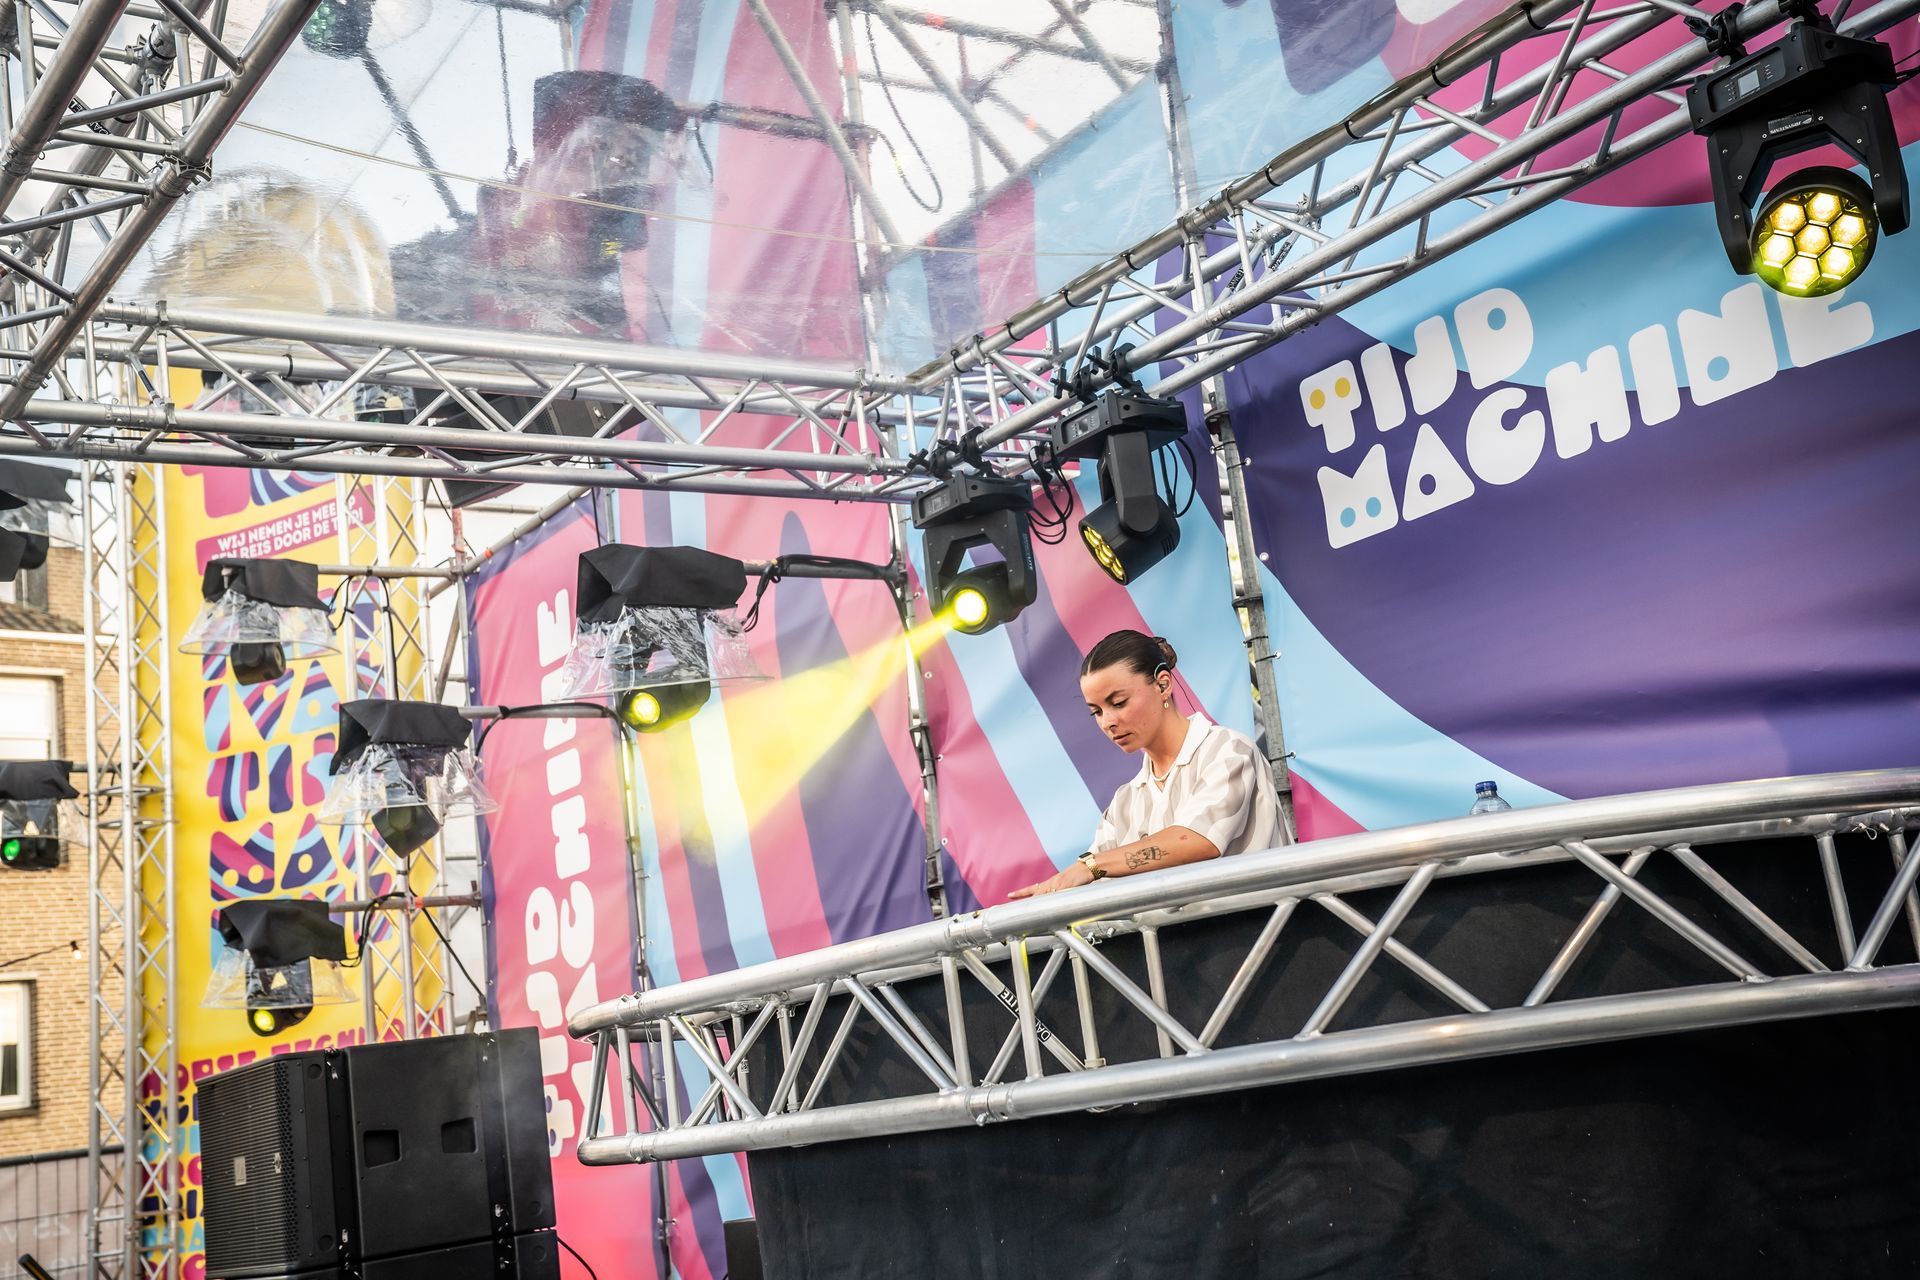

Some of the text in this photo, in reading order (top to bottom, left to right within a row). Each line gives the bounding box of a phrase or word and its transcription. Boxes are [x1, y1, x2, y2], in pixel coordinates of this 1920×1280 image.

[1299, 288, 1534, 453] TIJD
[1317, 282, 1875, 549] MACHINE
[217, 534, 246, 552] WIJ
[248, 516, 293, 544] NEMEN
[294, 511, 310, 528] JE
[240, 538, 271, 559] REIS
[274, 529, 311, 552] DOOR
[314, 520, 330, 537] DE
